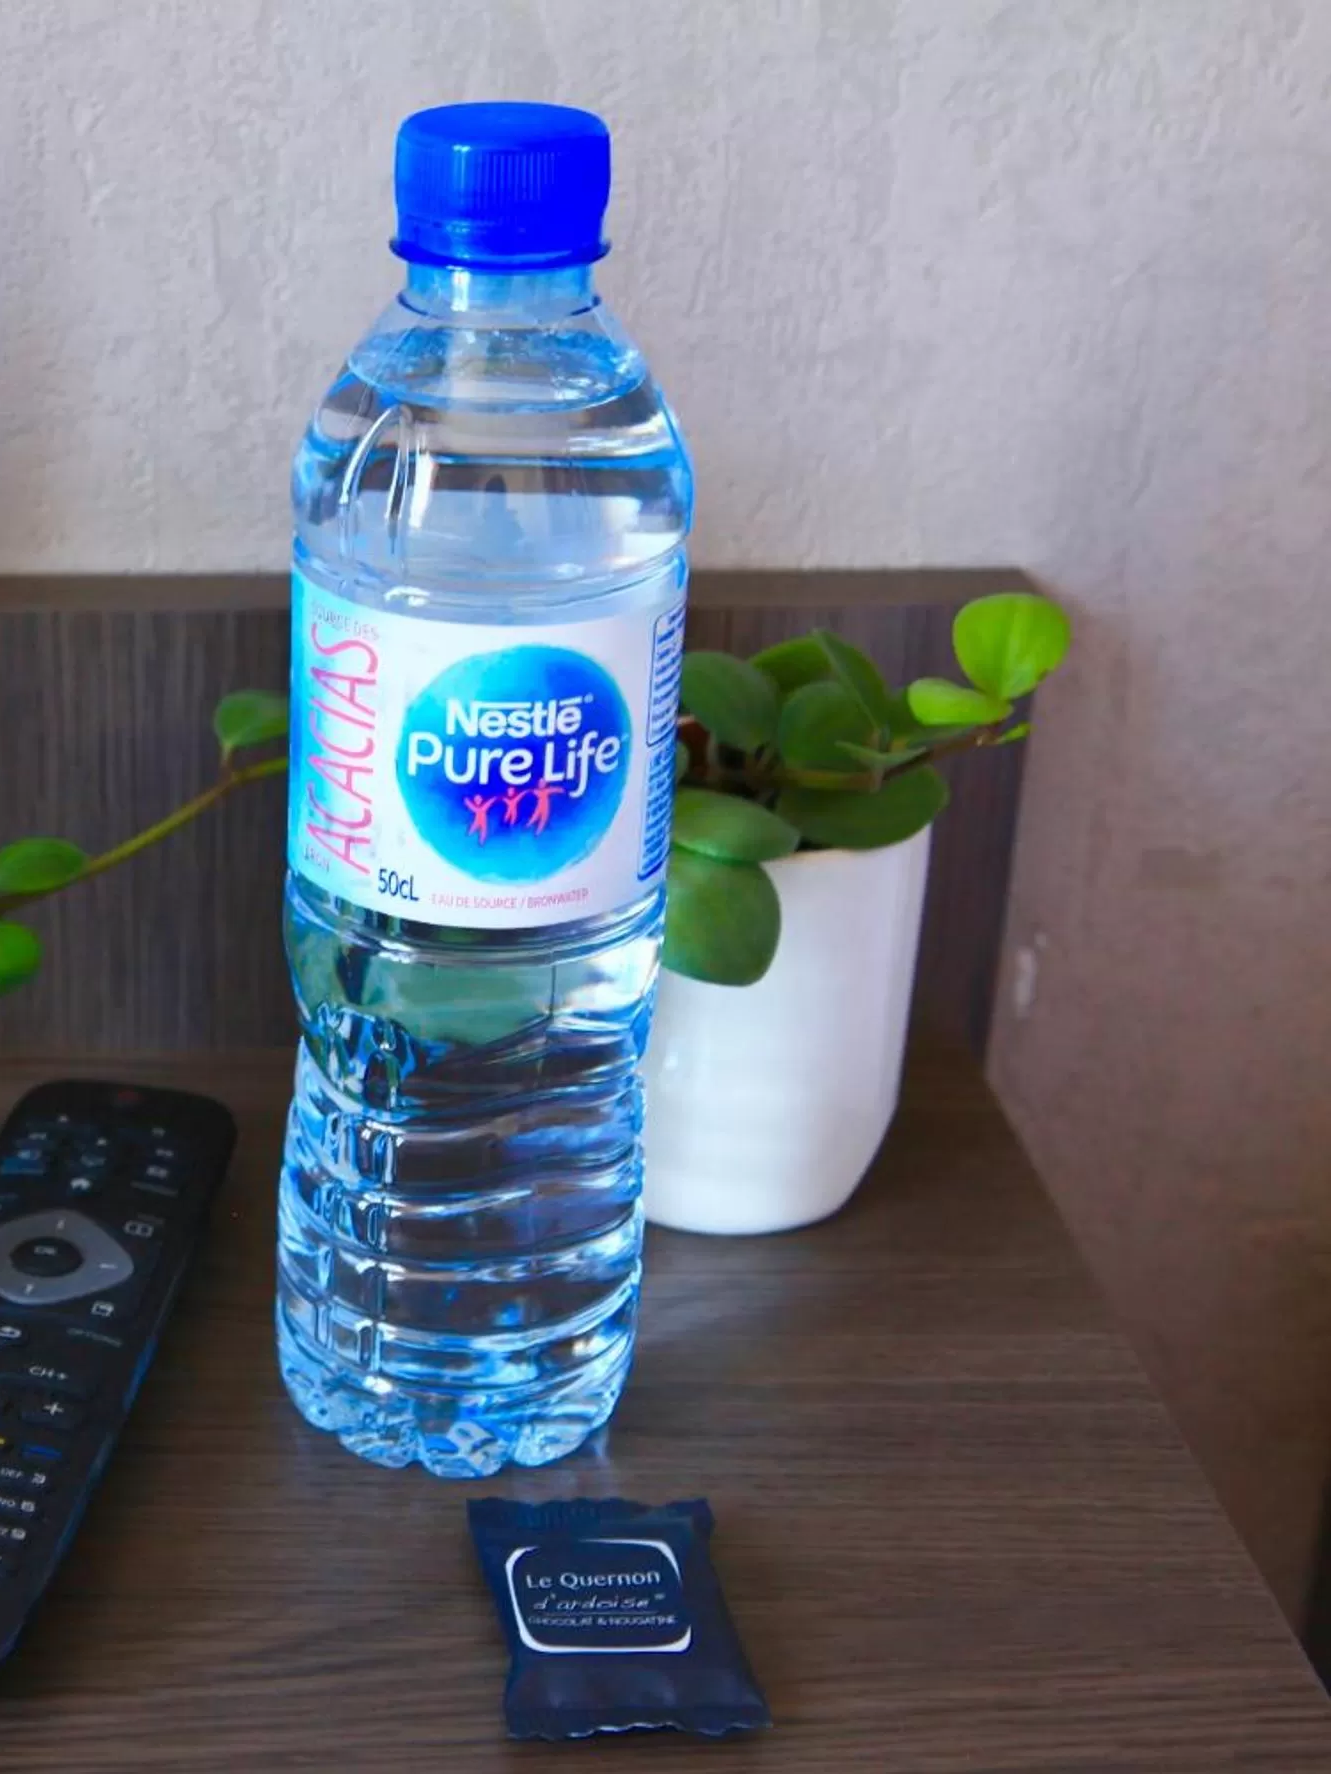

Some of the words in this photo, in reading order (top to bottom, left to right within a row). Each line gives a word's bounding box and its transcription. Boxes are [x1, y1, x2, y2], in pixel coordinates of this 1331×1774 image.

[306, 623, 379, 875] ACACIAS
[407, 732, 534, 785] Pure
[543, 731, 621, 797] Life
[378, 868, 420, 901] 50cL
[456, 896, 469, 908] DE
[474, 896, 517, 909] SOURCE
[527, 888, 589, 909] BRONWATER
[526, 1574, 553, 1589] Le
[560, 1570, 660, 1590] Quernon
